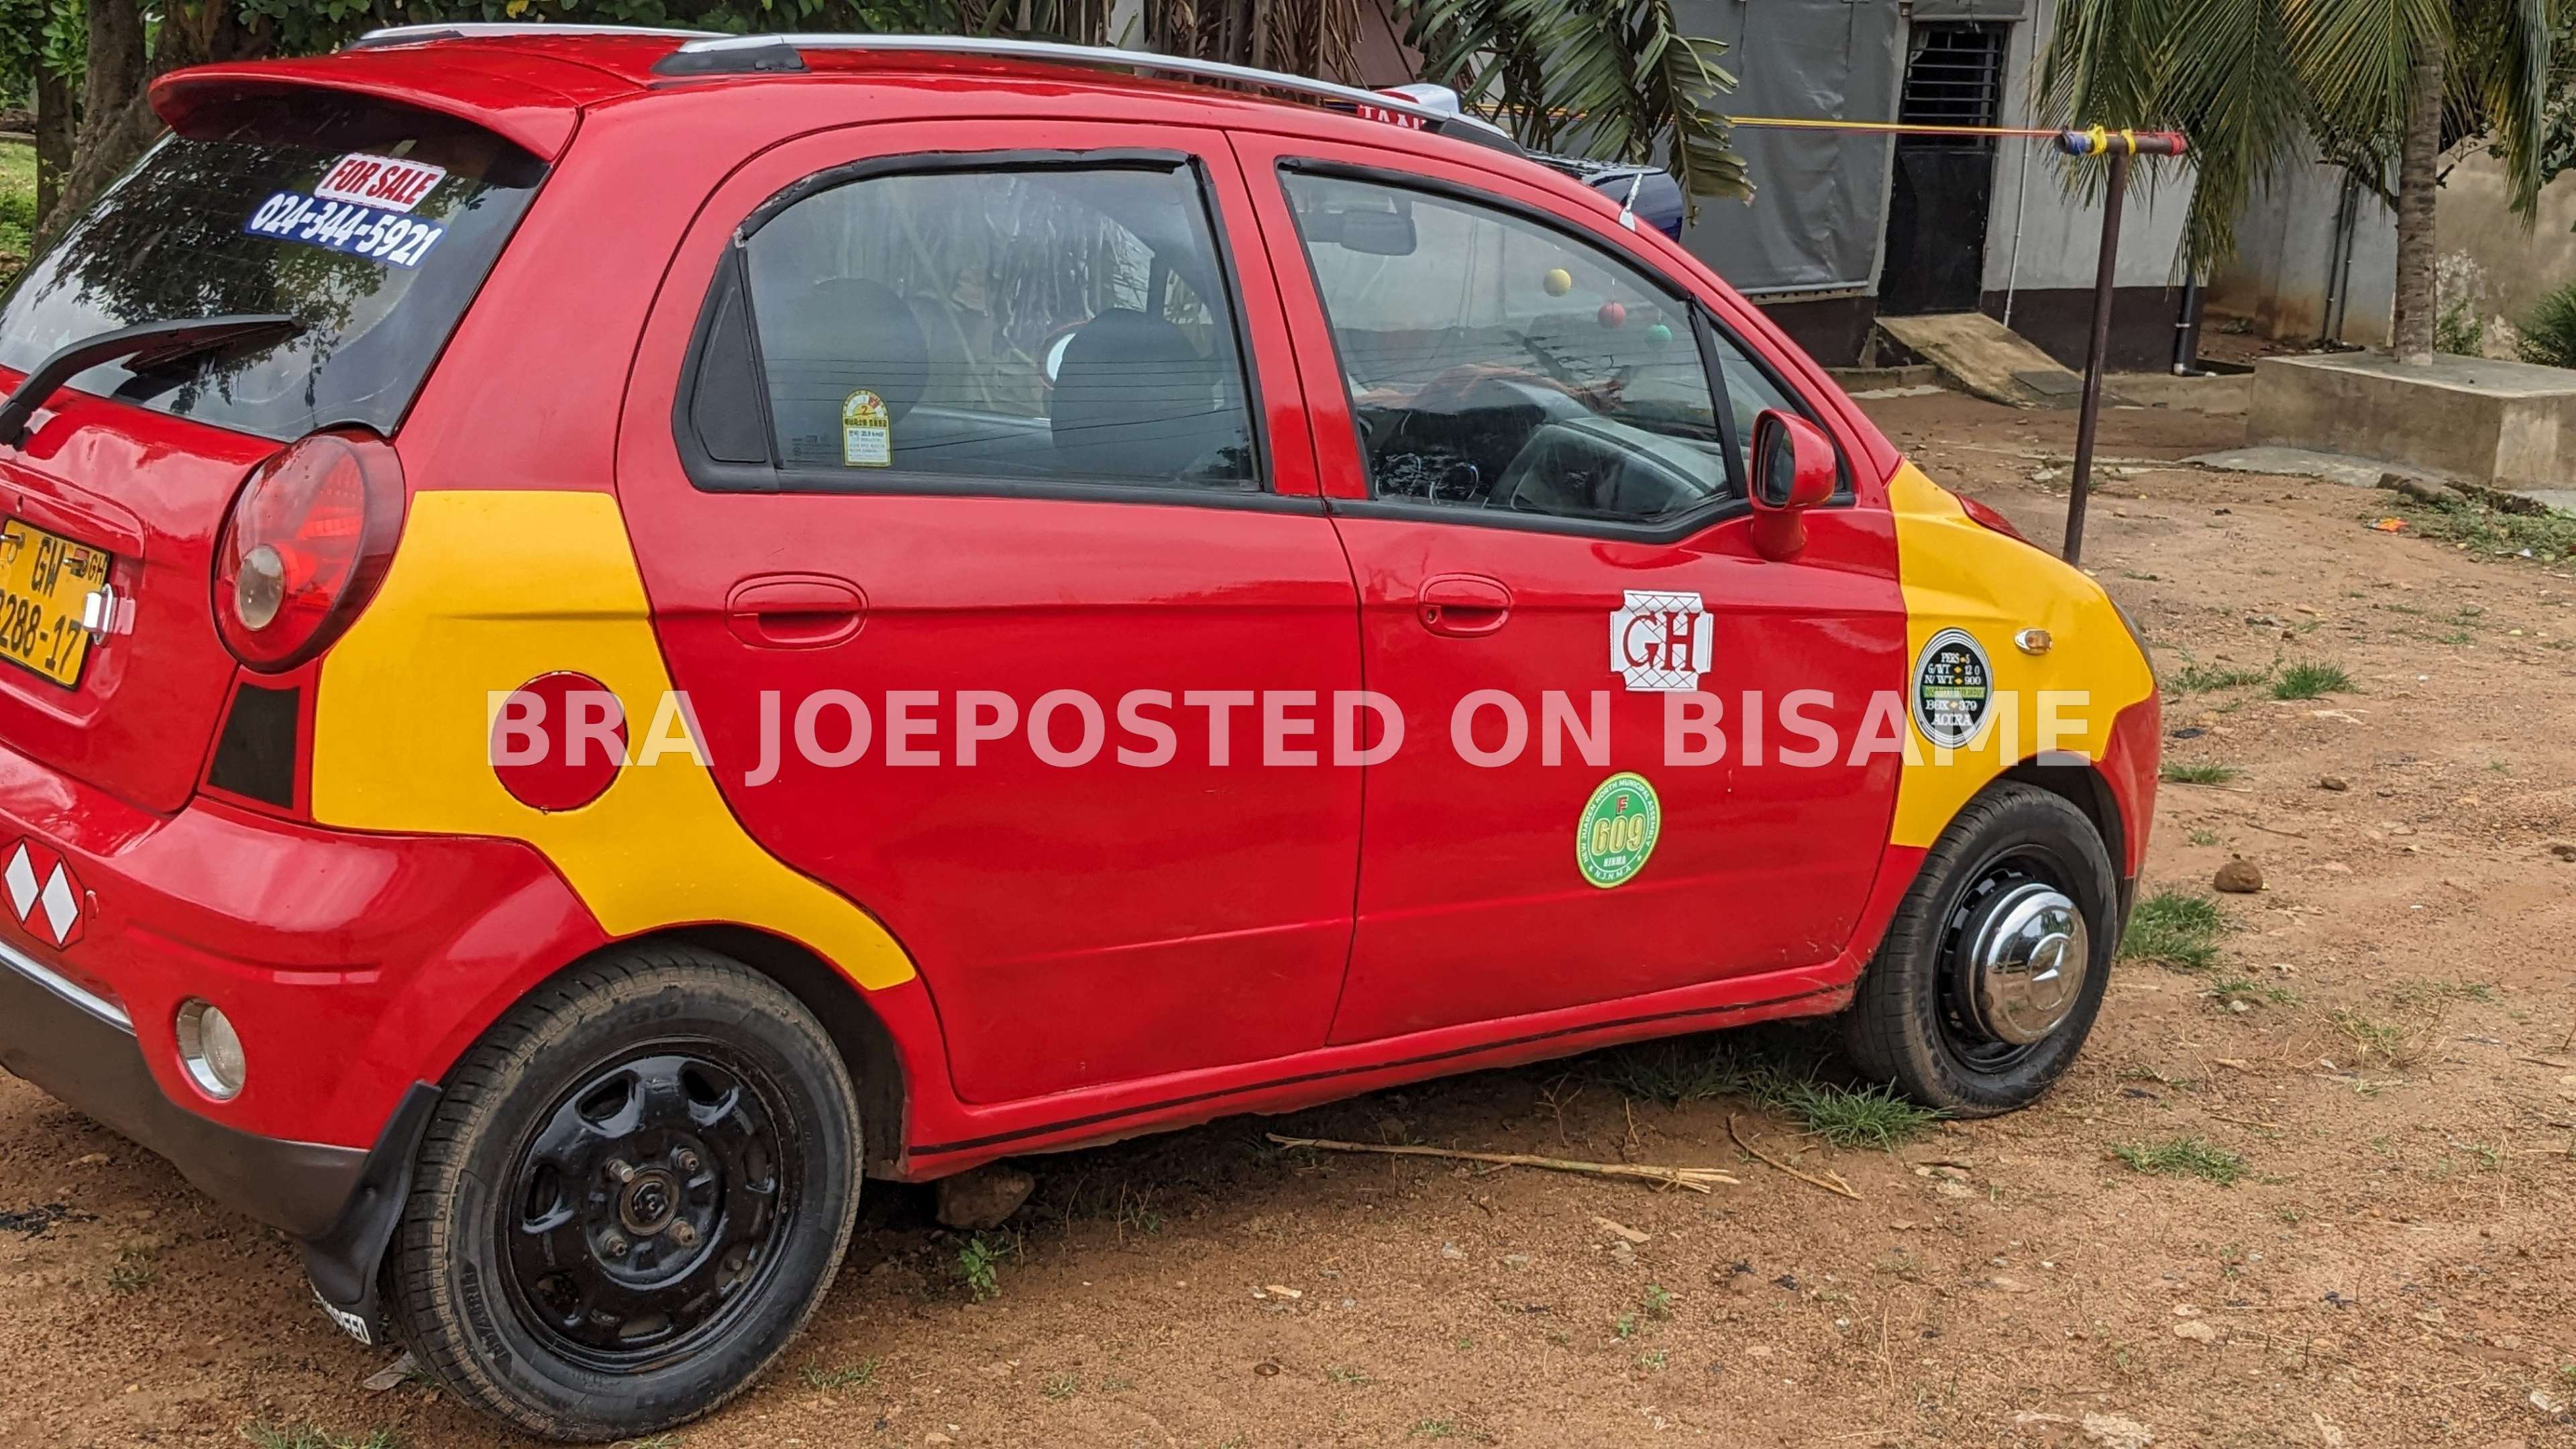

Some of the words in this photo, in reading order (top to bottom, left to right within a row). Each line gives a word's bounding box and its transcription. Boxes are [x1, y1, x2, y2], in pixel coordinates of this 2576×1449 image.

[1360, 105, 1419, 130] TAXI
[322, 159, 382, 194] FOR
[366, 165, 439, 205] SALE
[251, 193, 443, 266] 024-344-5921
[31, 537, 66, 598] GW
[88, 553, 106, 585] GH
[1623, 611, 1701, 672] GH
[1964, 676, 1981, 685] 900
[1925, 700, 1949, 710] BOX
[1958, 700, 1978, 710] 379
[1931, 713, 1972, 726] ACCRA
[1581, 843, 1589, 863] NEW
[1595, 782, 1618, 802] NORTH
[1619, 779, 1650, 801] MUNICIPAL
[1646, 800, 1656, 847] ASSEMBLY
[1616, 794, 1629, 814] F
[1591, 814, 1646, 856] 609
